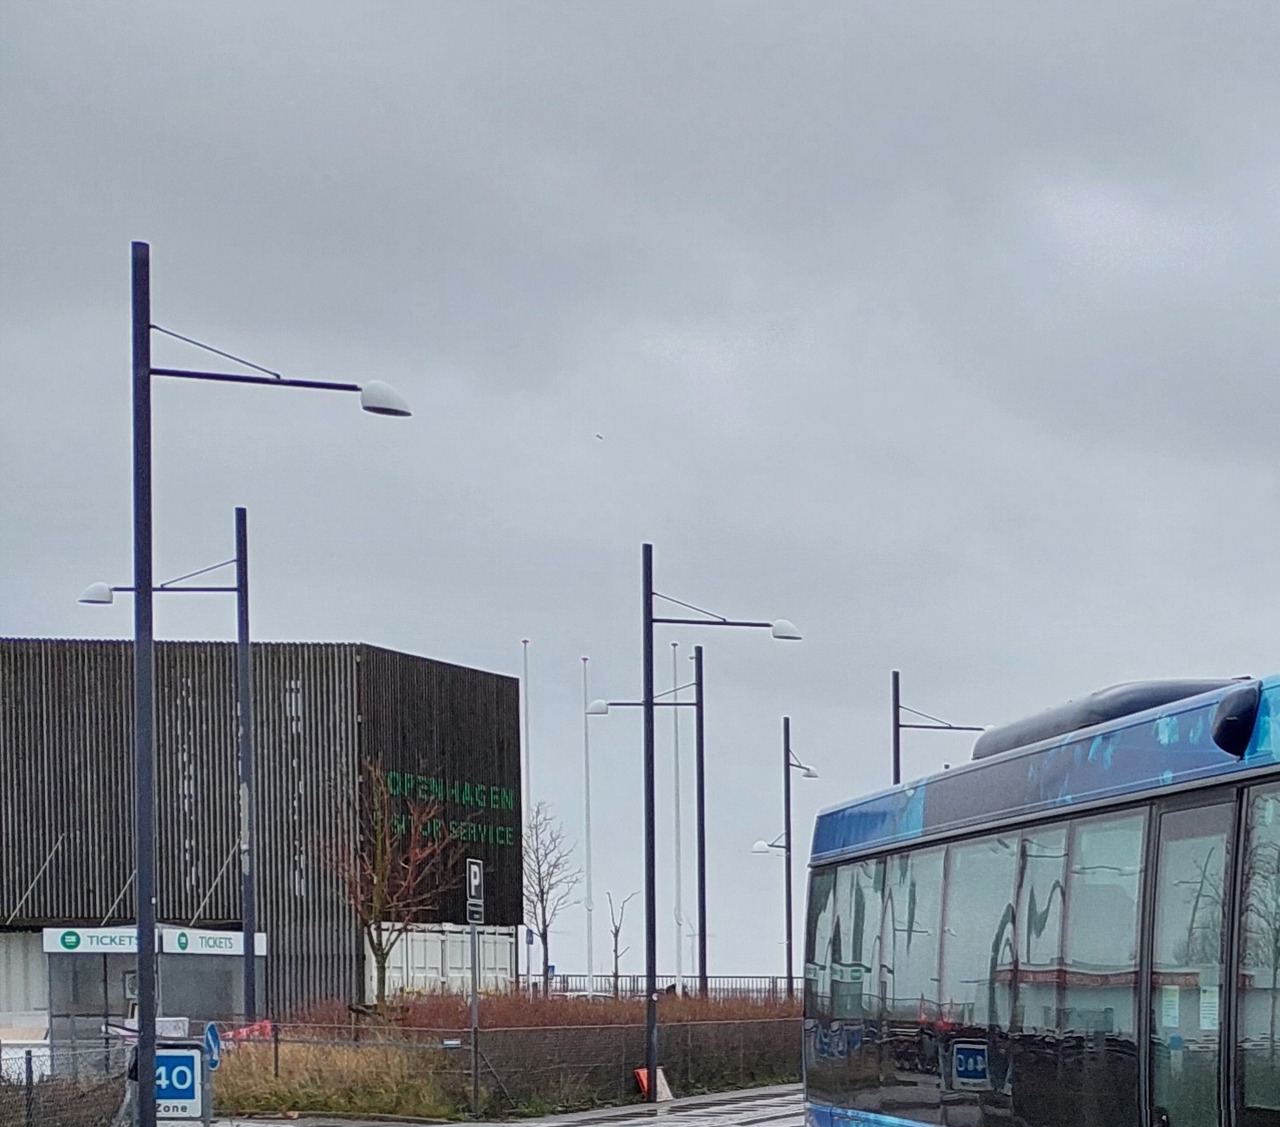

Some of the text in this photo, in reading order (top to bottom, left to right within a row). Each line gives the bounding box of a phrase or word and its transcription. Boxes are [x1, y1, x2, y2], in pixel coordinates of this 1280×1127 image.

[387, 770, 515, 811] OPENHAGEN
[449, 820, 515, 846] SERVICE
[470, 864, 480, 896] P
[199, 936, 233, 949] TICKETS
[155, 1066, 192, 1089] 40
